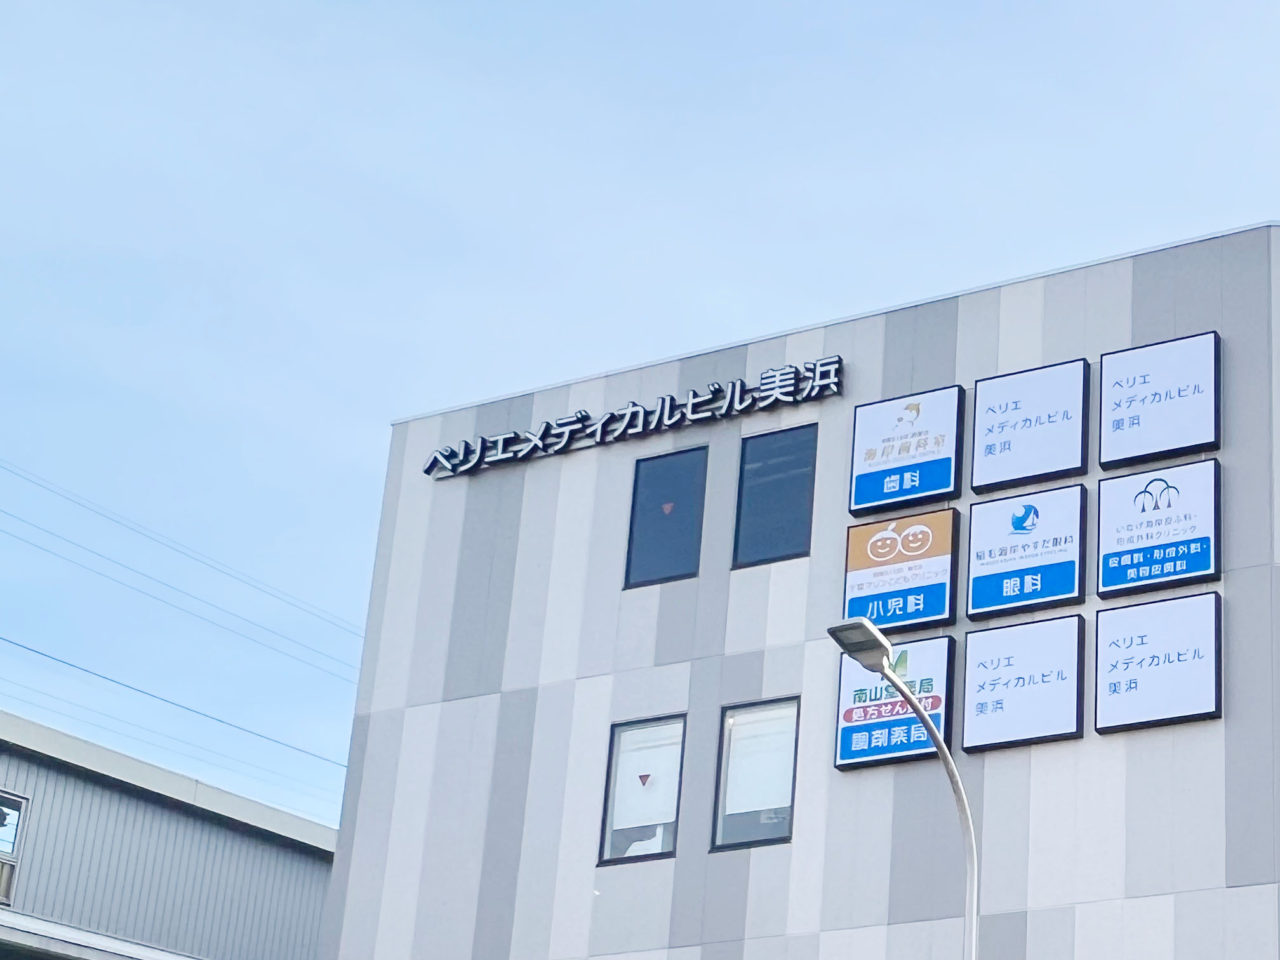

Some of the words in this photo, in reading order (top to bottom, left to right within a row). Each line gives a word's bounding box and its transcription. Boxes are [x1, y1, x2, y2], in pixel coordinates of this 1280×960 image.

[1112, 374, 1150, 389] ペリエ
[985, 401, 1022, 414] ペリエ
[1112, 384, 1205, 411] メディカルビル
[424, 356, 842, 479] ペリエメディカルビル美浜
[985, 410, 1072, 437] メディカルビル
[1003, 573, 1041, 596] 眼科
[867, 594, 923, 619] 小児科
[1108, 634, 1149, 649] ペリエ
[977, 656, 1014, 670] ペリエ
[1107, 648, 1205, 673] メディカルビル
[976, 669, 1068, 693] メディカルビル
[852, 697, 932, 721] 処方せん付
[851, 723, 928, 751] 調剤薬局
